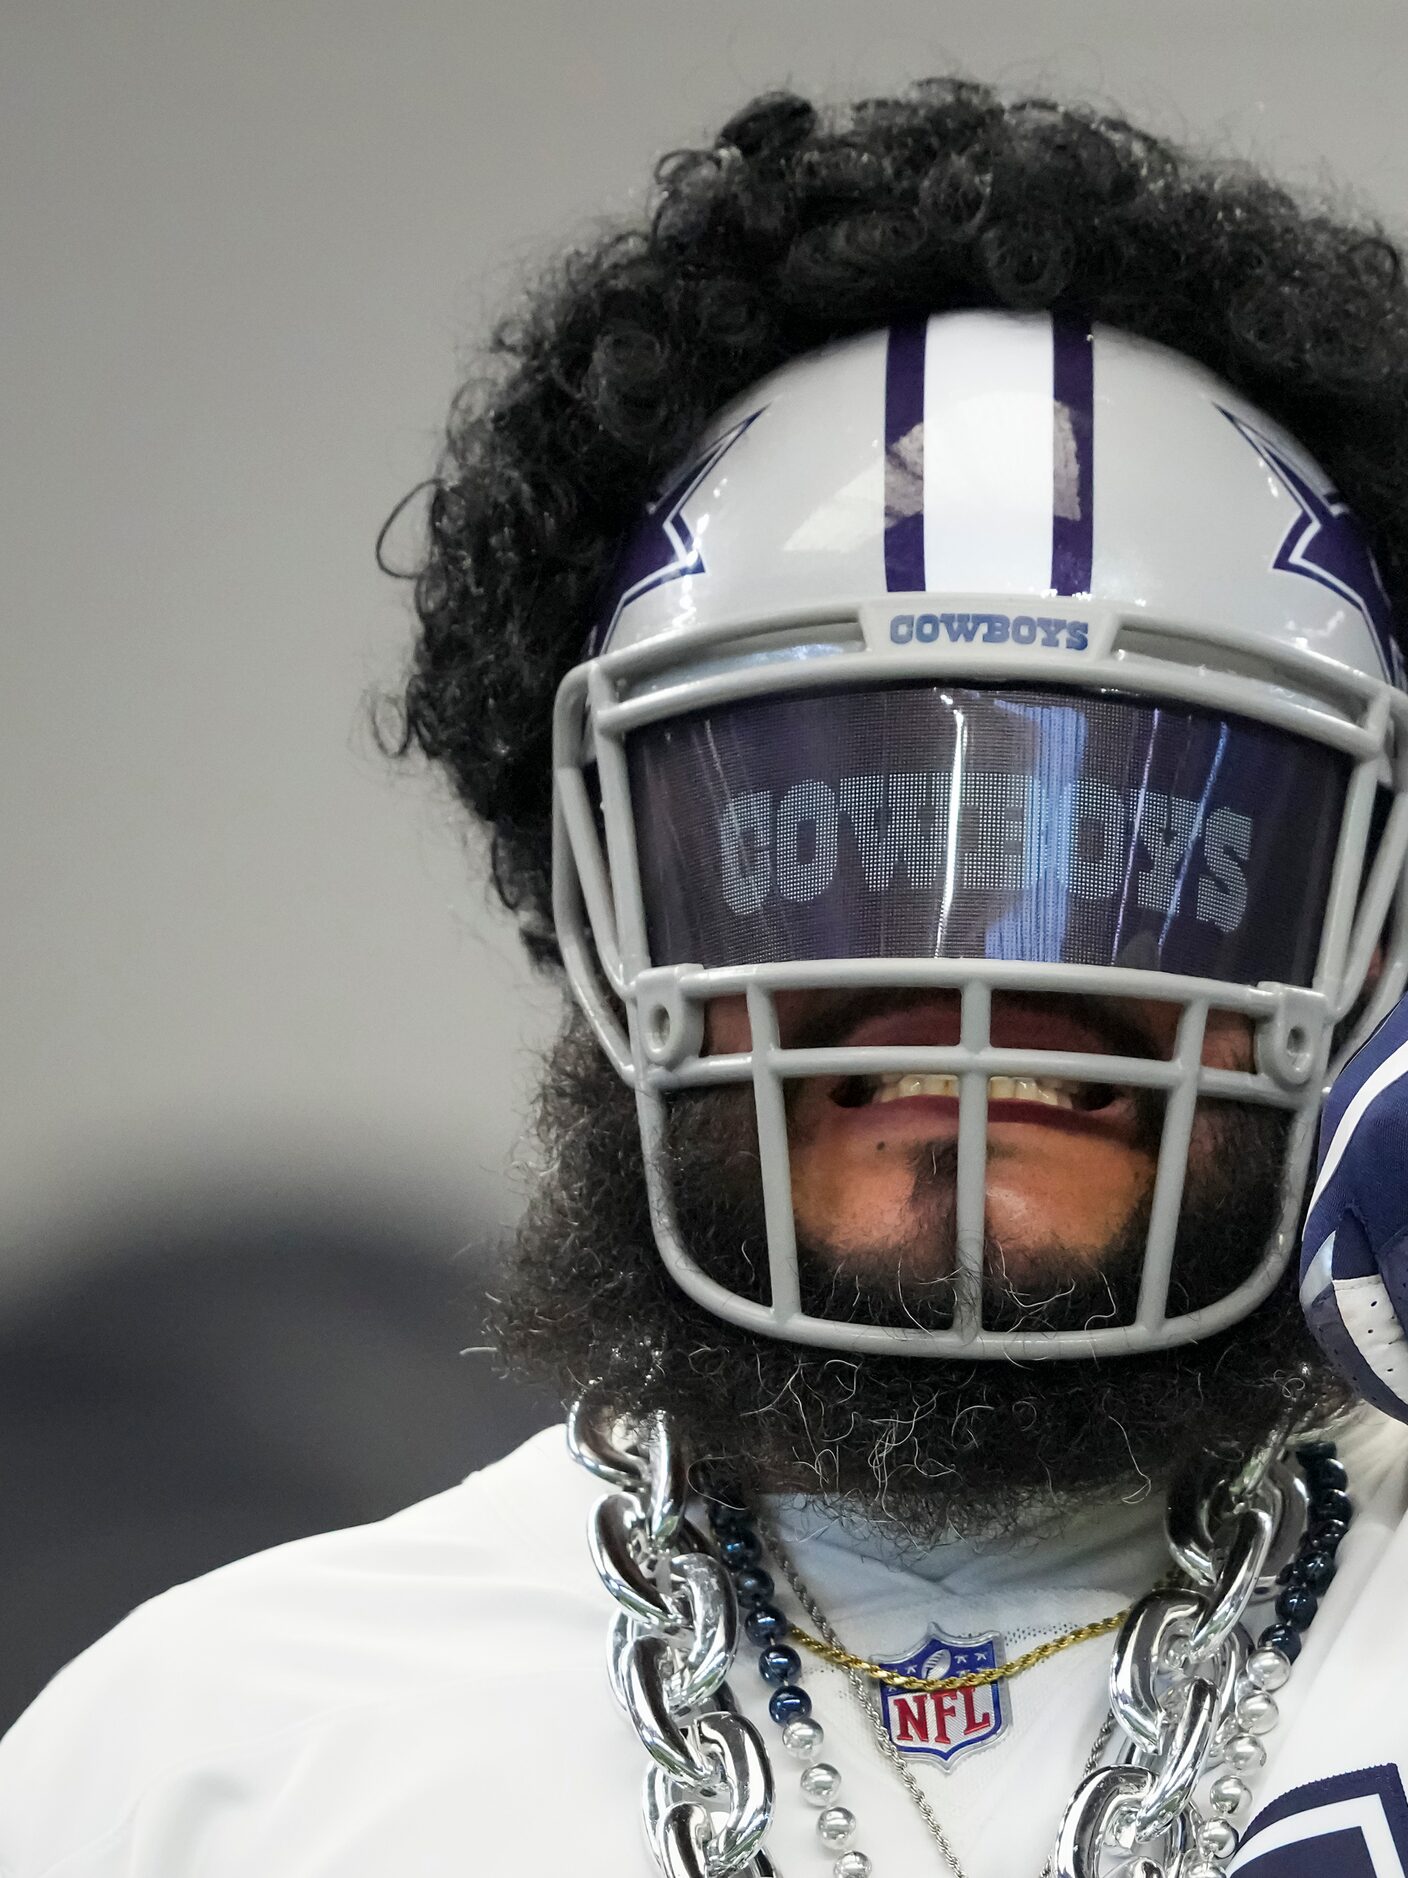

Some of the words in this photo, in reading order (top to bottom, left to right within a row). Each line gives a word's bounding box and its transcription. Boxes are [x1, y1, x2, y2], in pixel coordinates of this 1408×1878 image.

[890, 613, 1089, 650] COWBOYS
[719, 772, 1252, 933] COWBOYS
[893, 1685, 991, 1744] NFL
